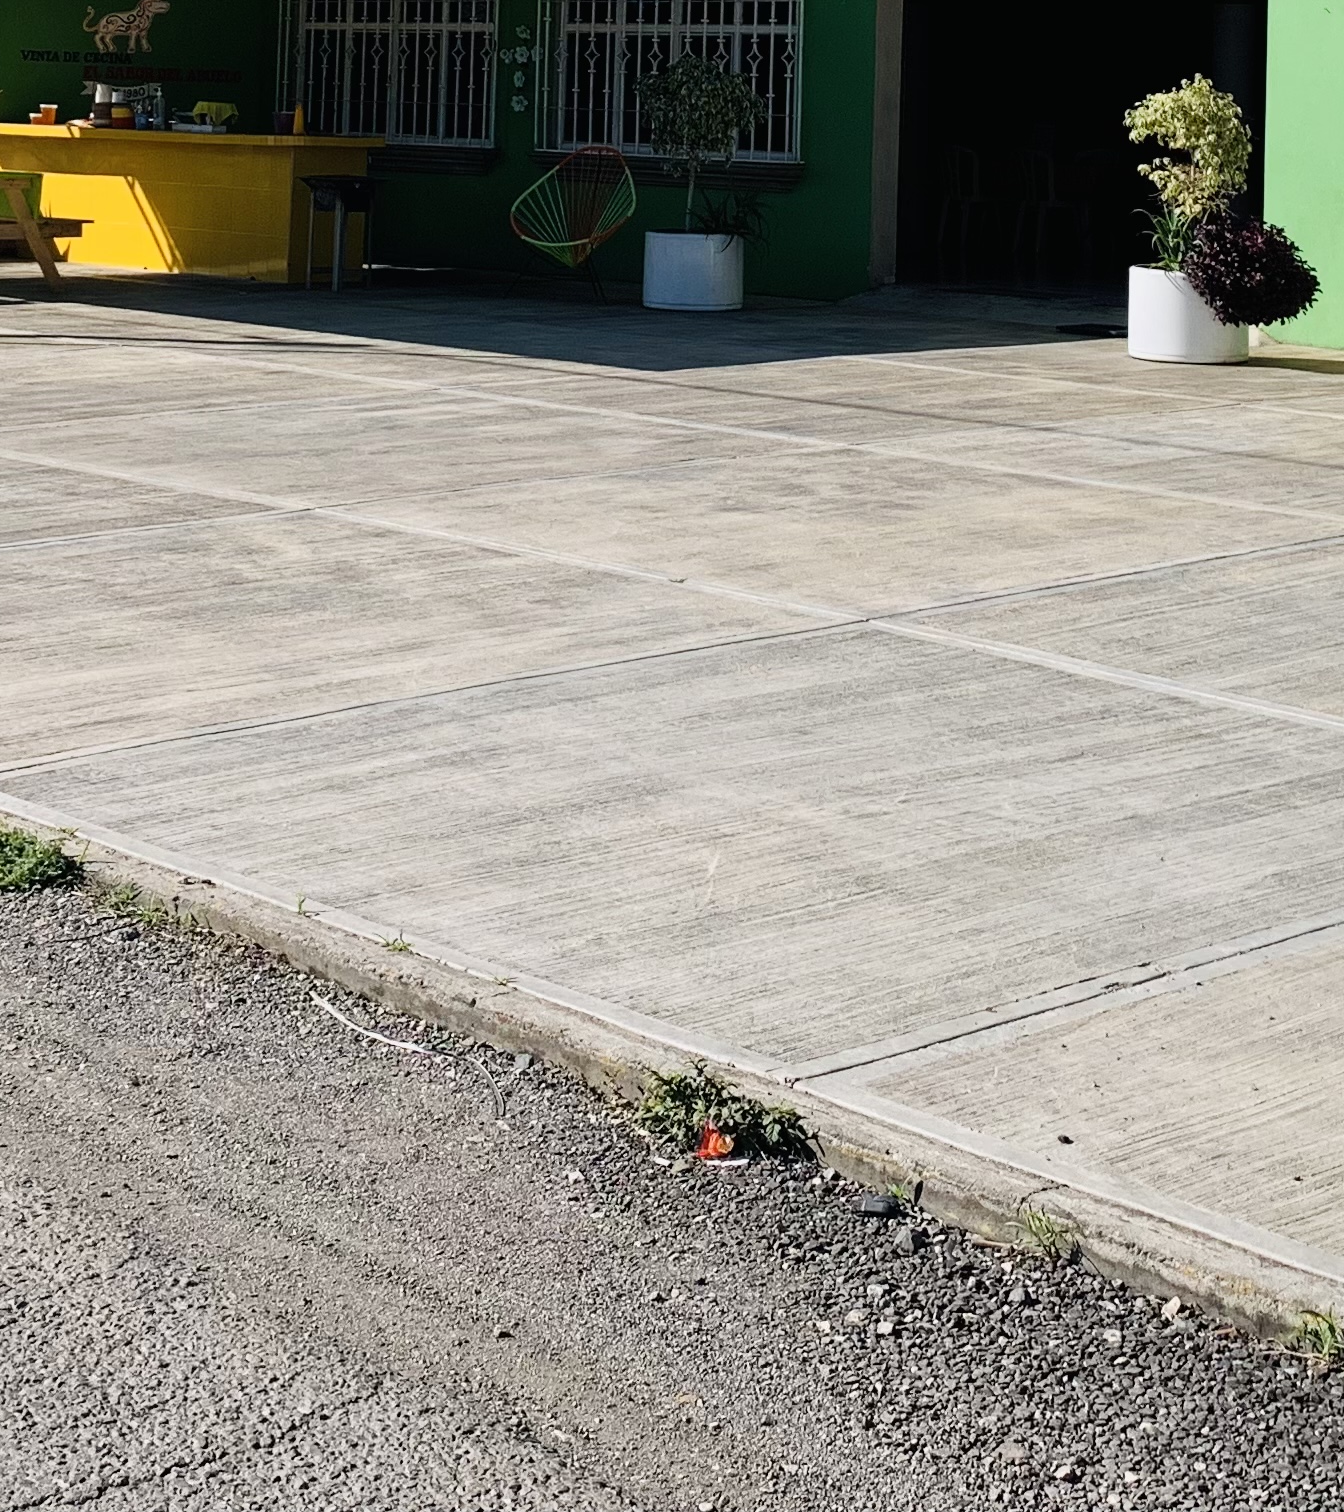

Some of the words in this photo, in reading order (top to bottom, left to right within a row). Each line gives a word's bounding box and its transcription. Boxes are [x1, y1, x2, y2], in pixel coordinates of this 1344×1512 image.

[20, 49, 60, 63] VENTA
[63, 50, 81, 63] DE
[84, 51, 134, 65] CECINA
